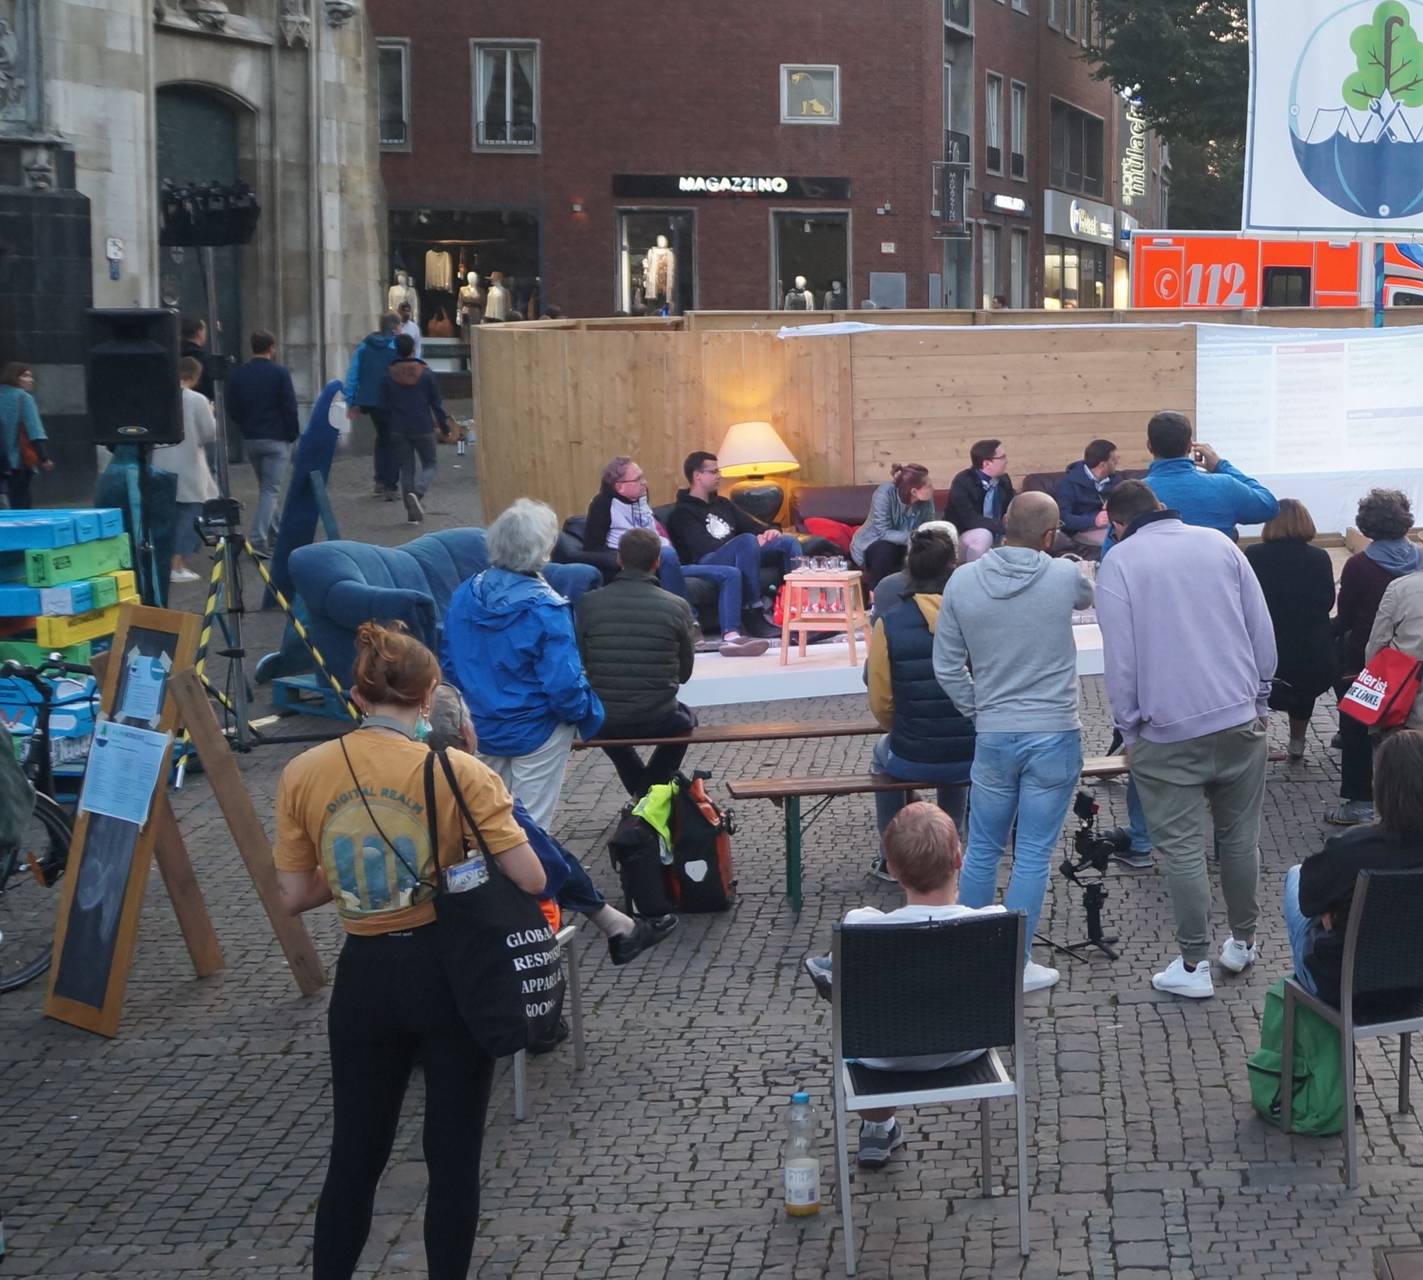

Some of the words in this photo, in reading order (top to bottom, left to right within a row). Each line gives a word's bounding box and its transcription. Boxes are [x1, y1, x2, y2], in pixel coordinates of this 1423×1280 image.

[679, 177, 788, 192] MAGAZZINO
[948, 172, 957, 222] MAGAZZINO
[1184, 262, 1247, 306] 112
[326, 786, 377, 813] DIGITAL
[380, 786, 424, 815] REALM
